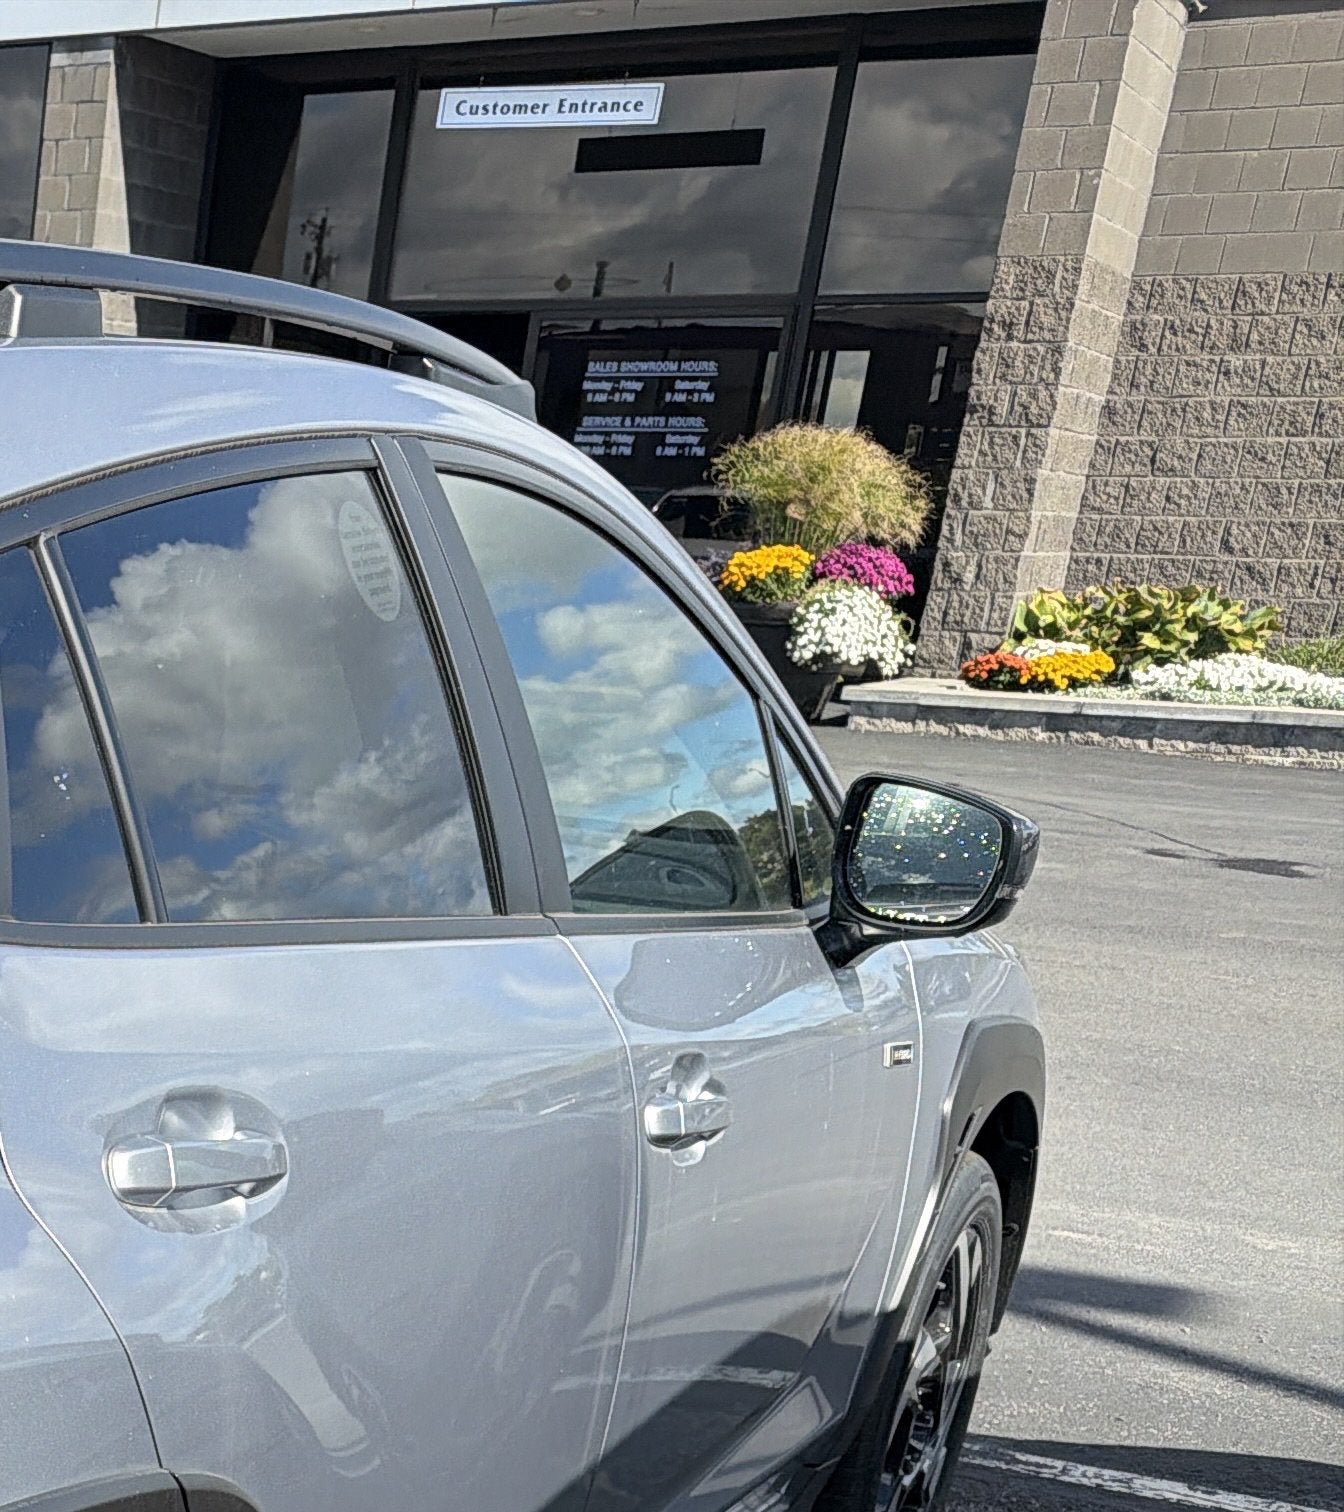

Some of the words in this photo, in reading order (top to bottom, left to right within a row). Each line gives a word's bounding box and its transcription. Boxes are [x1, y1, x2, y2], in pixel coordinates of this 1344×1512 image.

[455, 99, 550, 116] Customer
[557, 98, 644, 114] Entrance
[587, 360, 619, 372] SALES
[620, 360, 679, 372] SHOWROOM
[582, 416, 623, 427] SERVICE
[634, 416, 666, 427] PARTS
